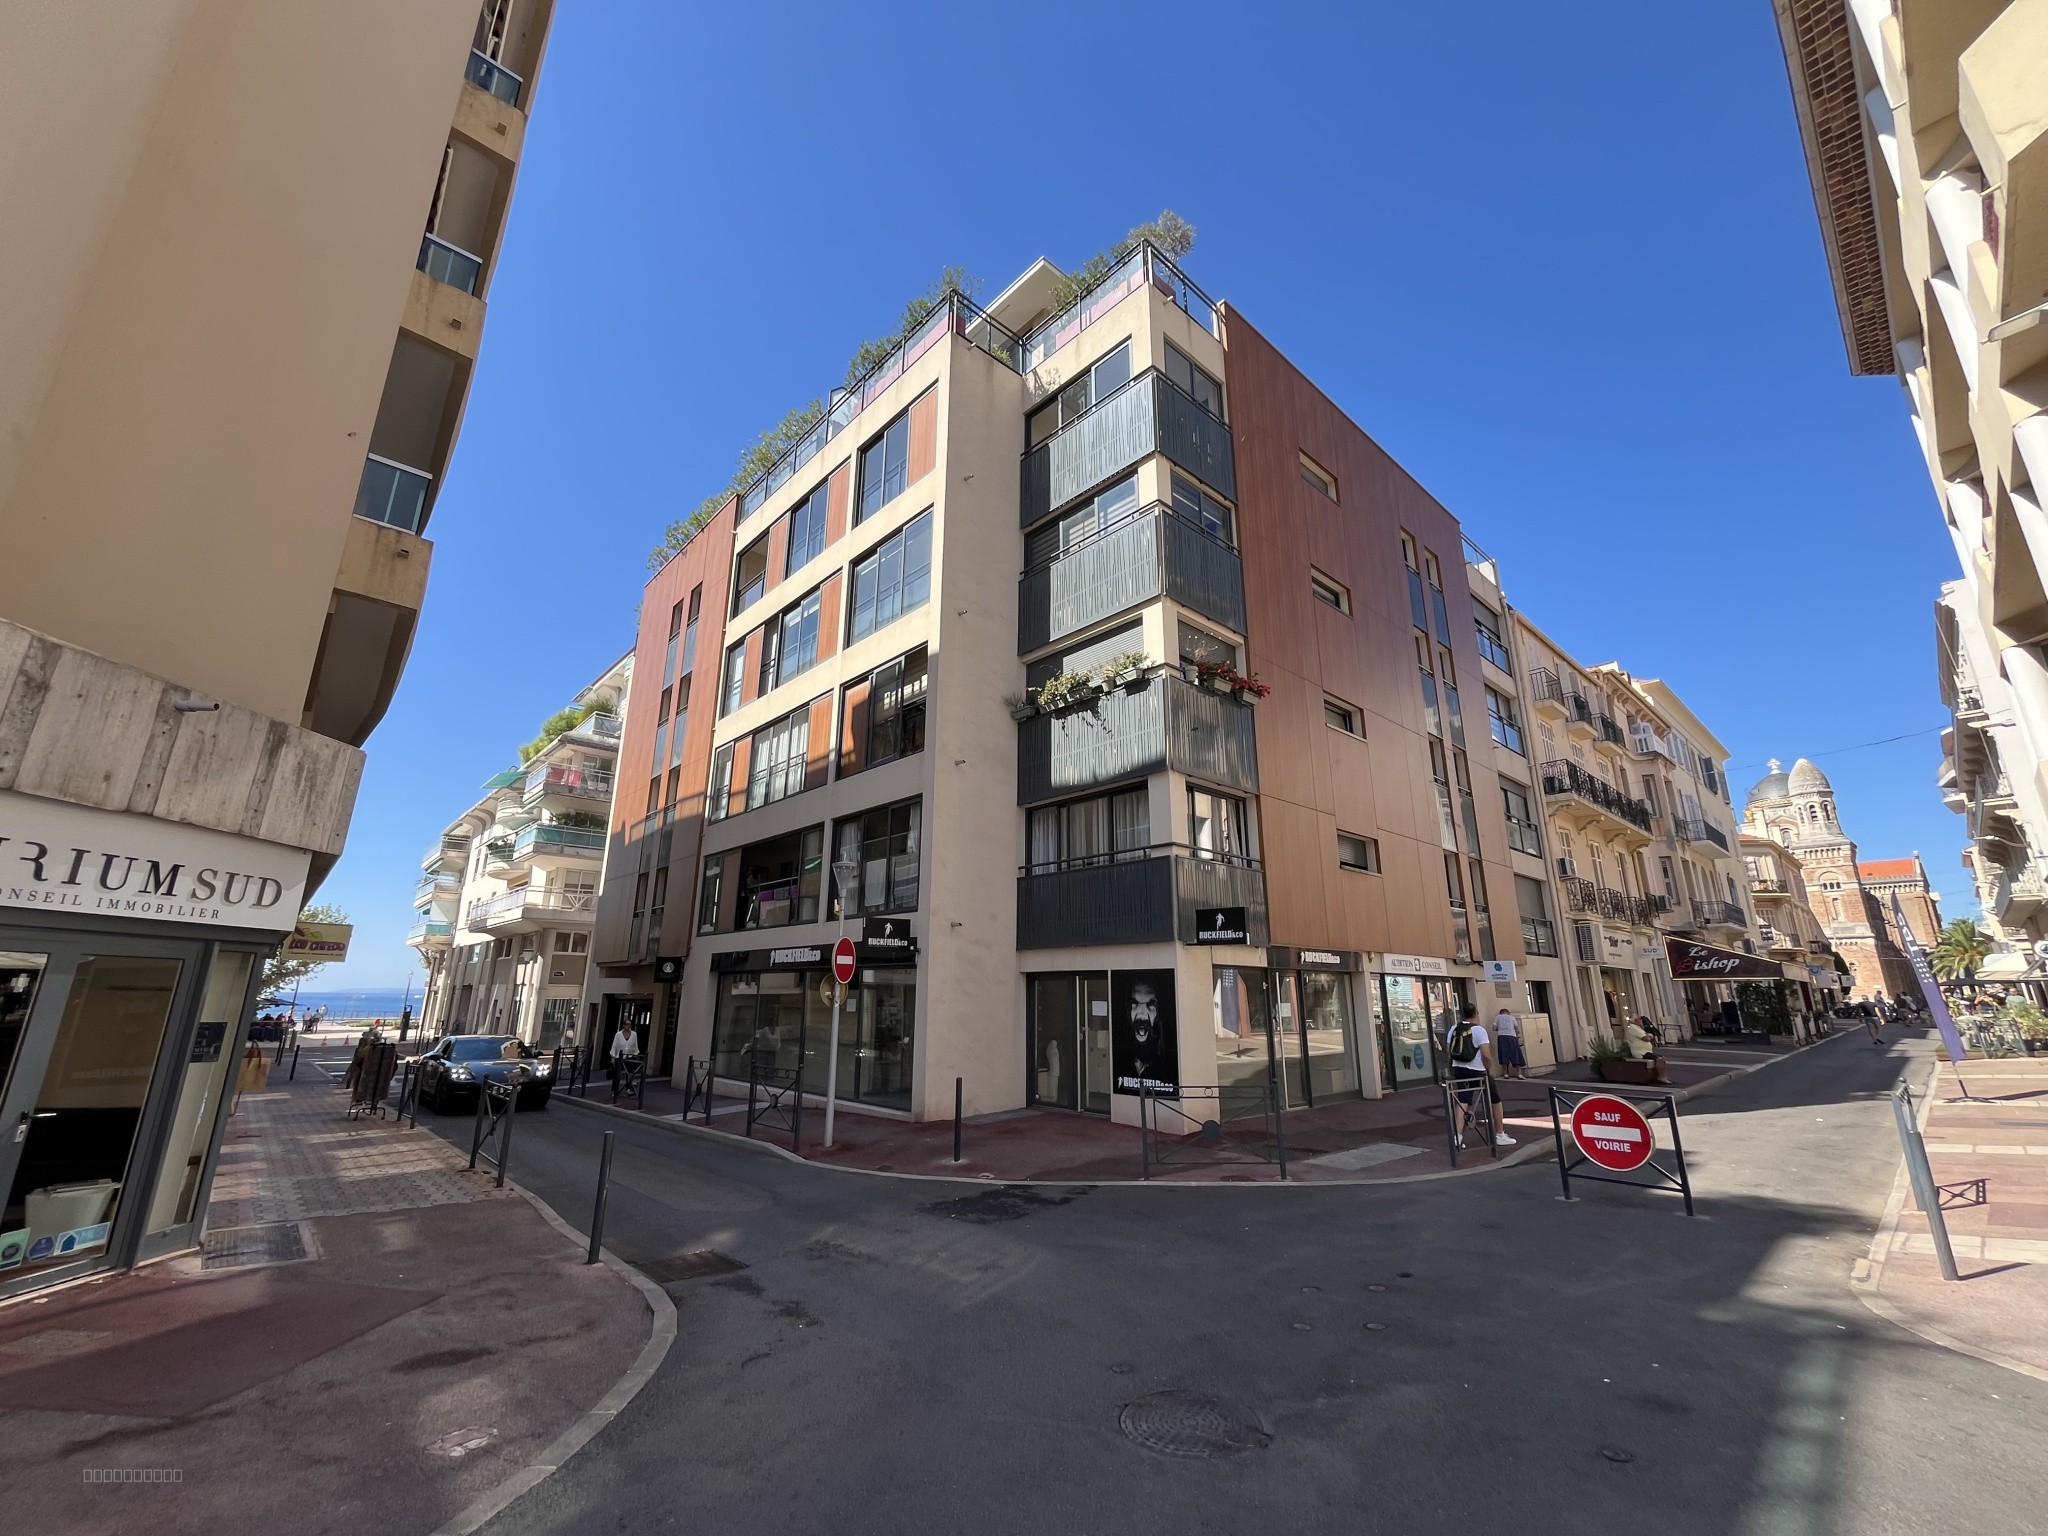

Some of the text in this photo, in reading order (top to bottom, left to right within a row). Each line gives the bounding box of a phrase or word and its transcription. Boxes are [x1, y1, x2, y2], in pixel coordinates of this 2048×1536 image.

[0, 837, 283, 909] RIUM SUD
[0, 887, 220, 919] NSEIL IMMOBILIER
[1688, 946, 1708, 957] Le
[1675, 956, 1740, 974] Bishop
[1594, 1111, 1621, 1123] SAUF
[1594, 1139, 1632, 1153] VOIRIE
